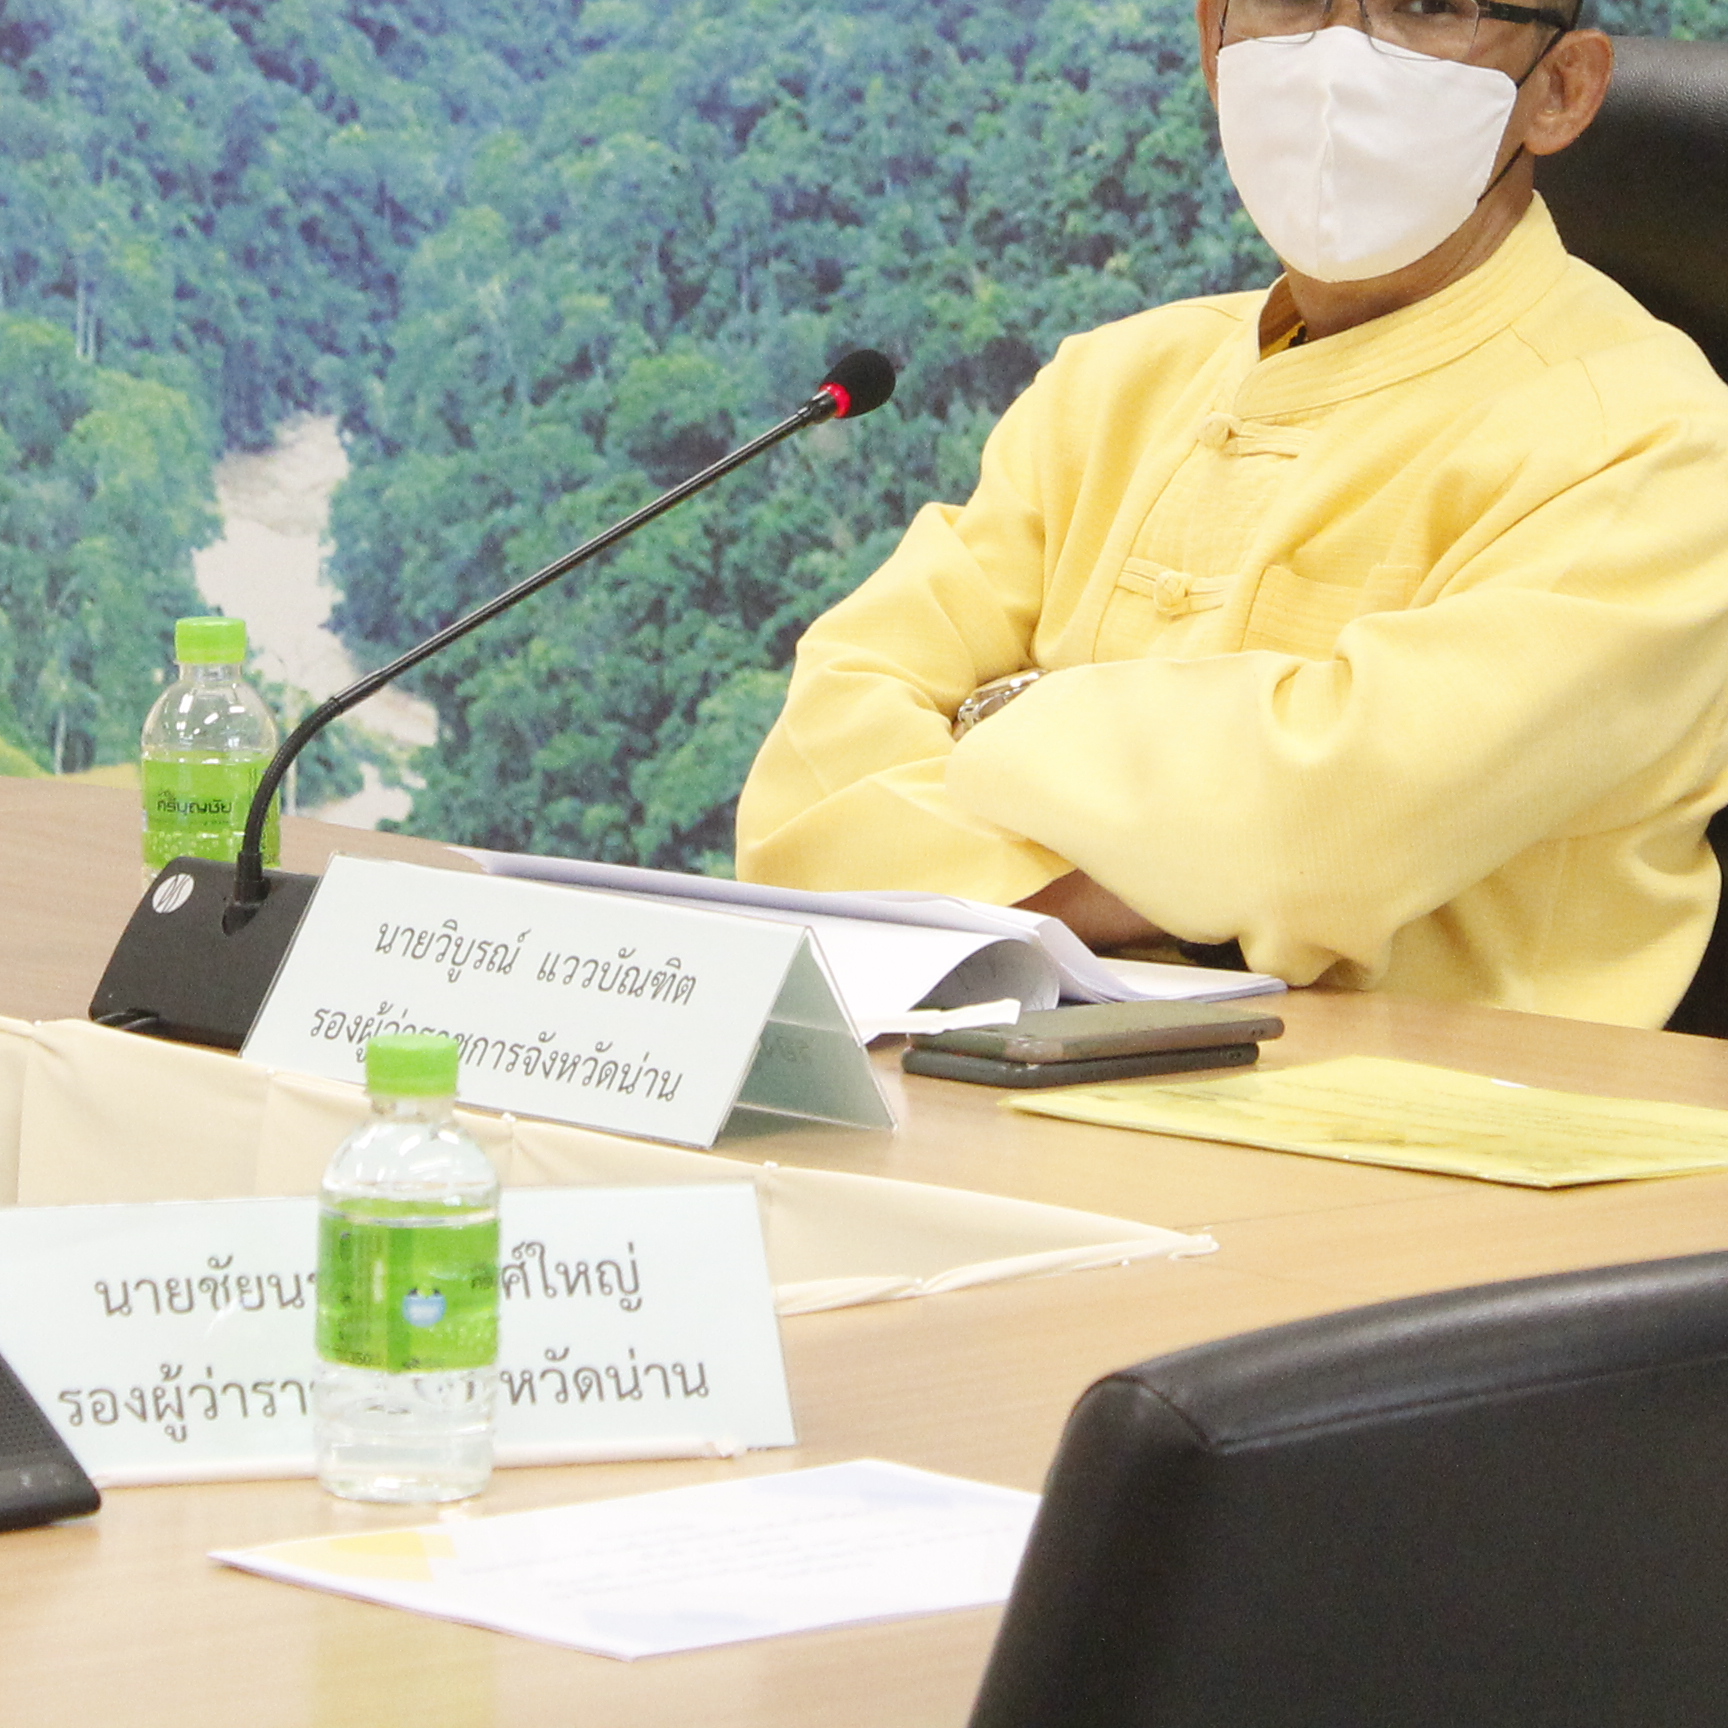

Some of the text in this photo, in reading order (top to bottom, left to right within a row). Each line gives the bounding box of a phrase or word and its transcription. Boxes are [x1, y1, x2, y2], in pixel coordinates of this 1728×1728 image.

[374, 918, 697, 1006] นายวิบูรณ์ แววบัณฑิต
[94, 1251, 315, 1317] นายชัยน
[500, 1241, 642, 1312] ศ์ใหญ่
